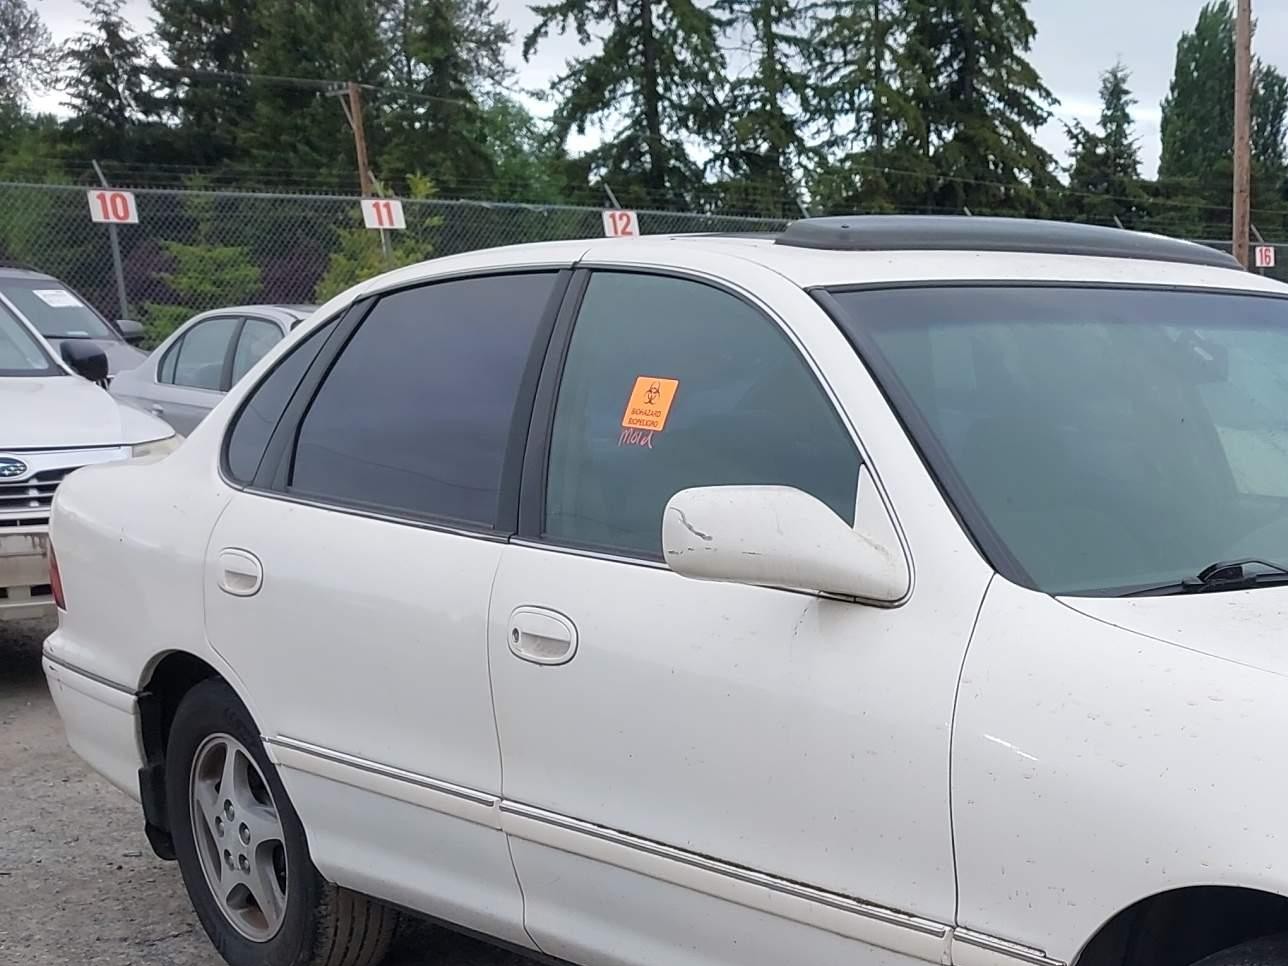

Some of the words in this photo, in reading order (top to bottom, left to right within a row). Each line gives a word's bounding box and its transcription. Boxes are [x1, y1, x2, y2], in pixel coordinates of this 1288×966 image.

[96, 192, 129, 221] 10
[372, 201, 394, 226] 11
[609, 212, 632, 235] 12
[1260, 248, 1271, 265] 16
[631, 408, 661, 417] BIOHAZARD
